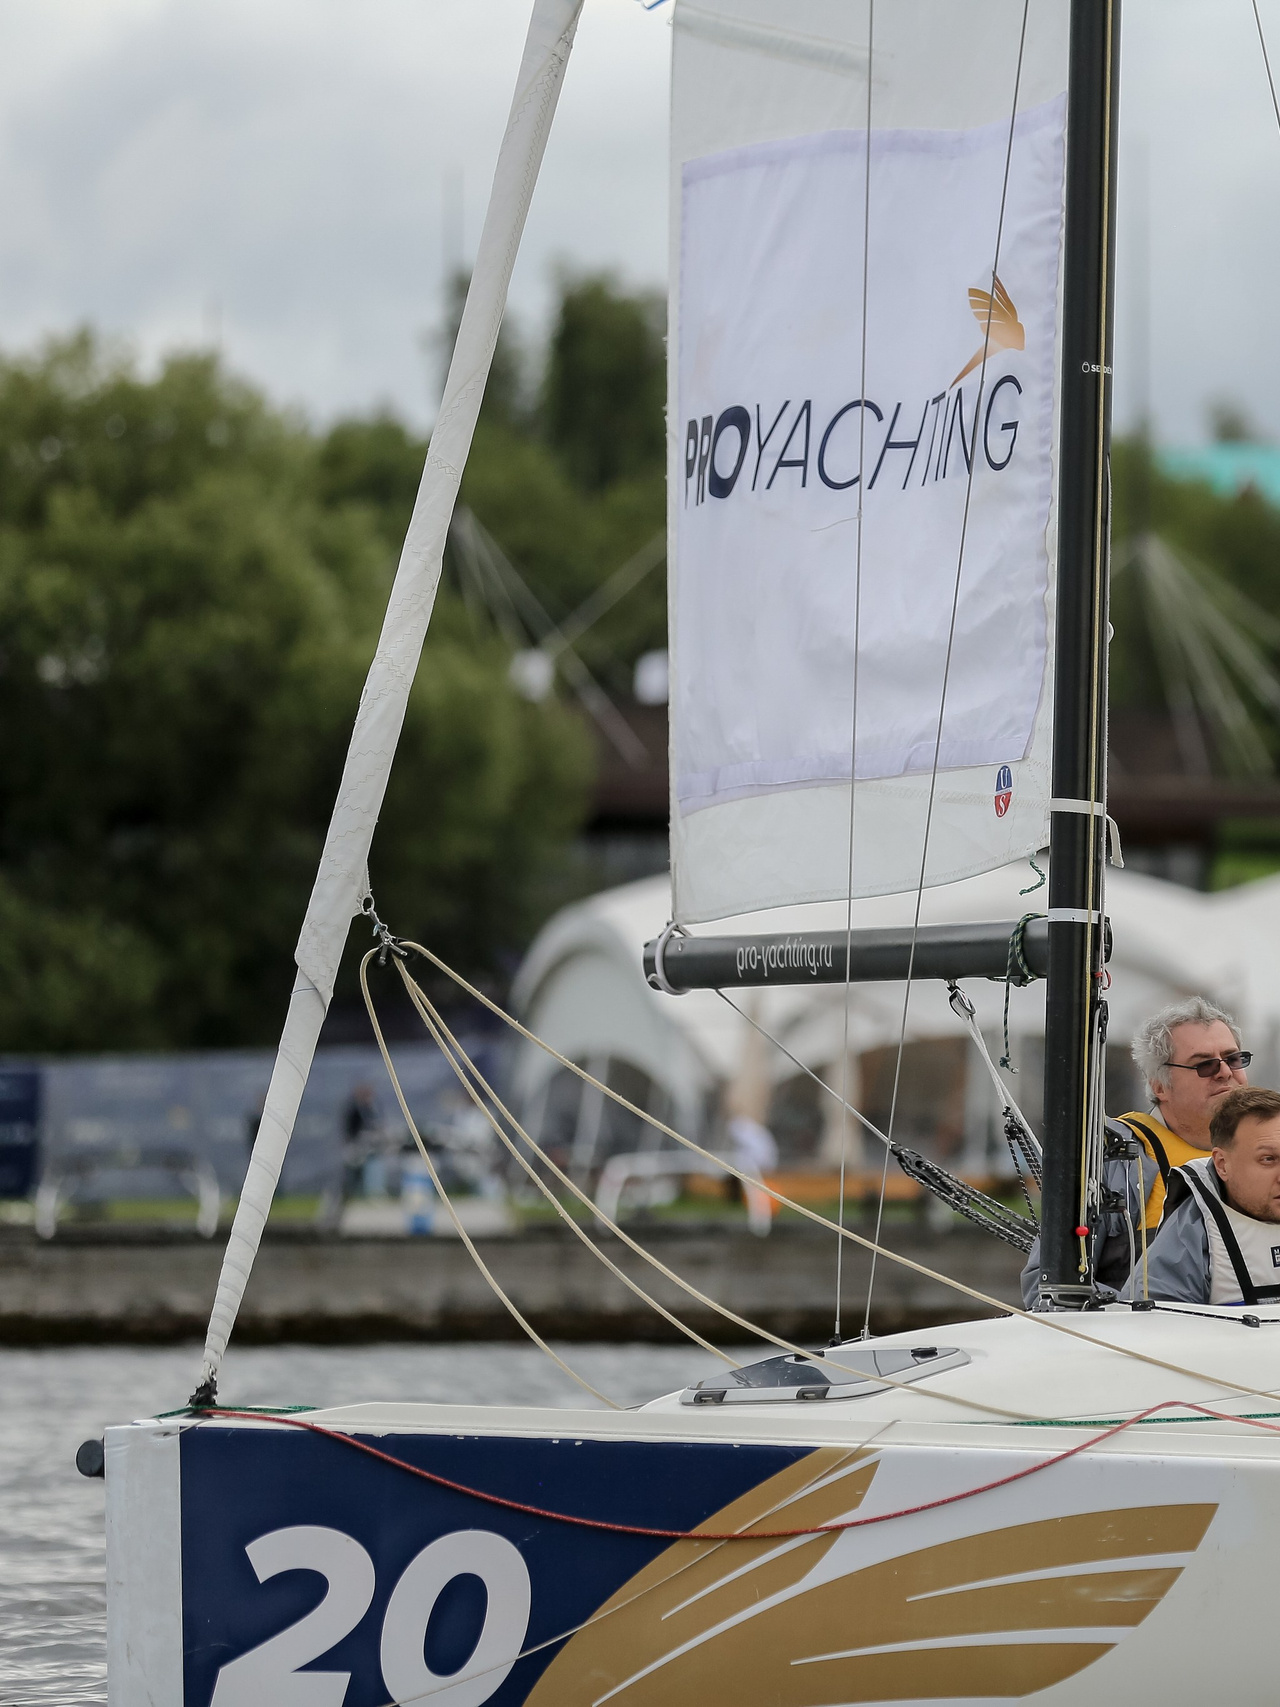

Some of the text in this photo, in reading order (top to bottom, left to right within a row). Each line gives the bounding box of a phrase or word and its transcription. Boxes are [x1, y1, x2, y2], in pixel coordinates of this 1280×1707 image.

[684, 374, 1023, 510] PROYACHTING
[736, 936, 833, 978] pro-yachting.ru
[209, 1524, 532, 1707] 20
